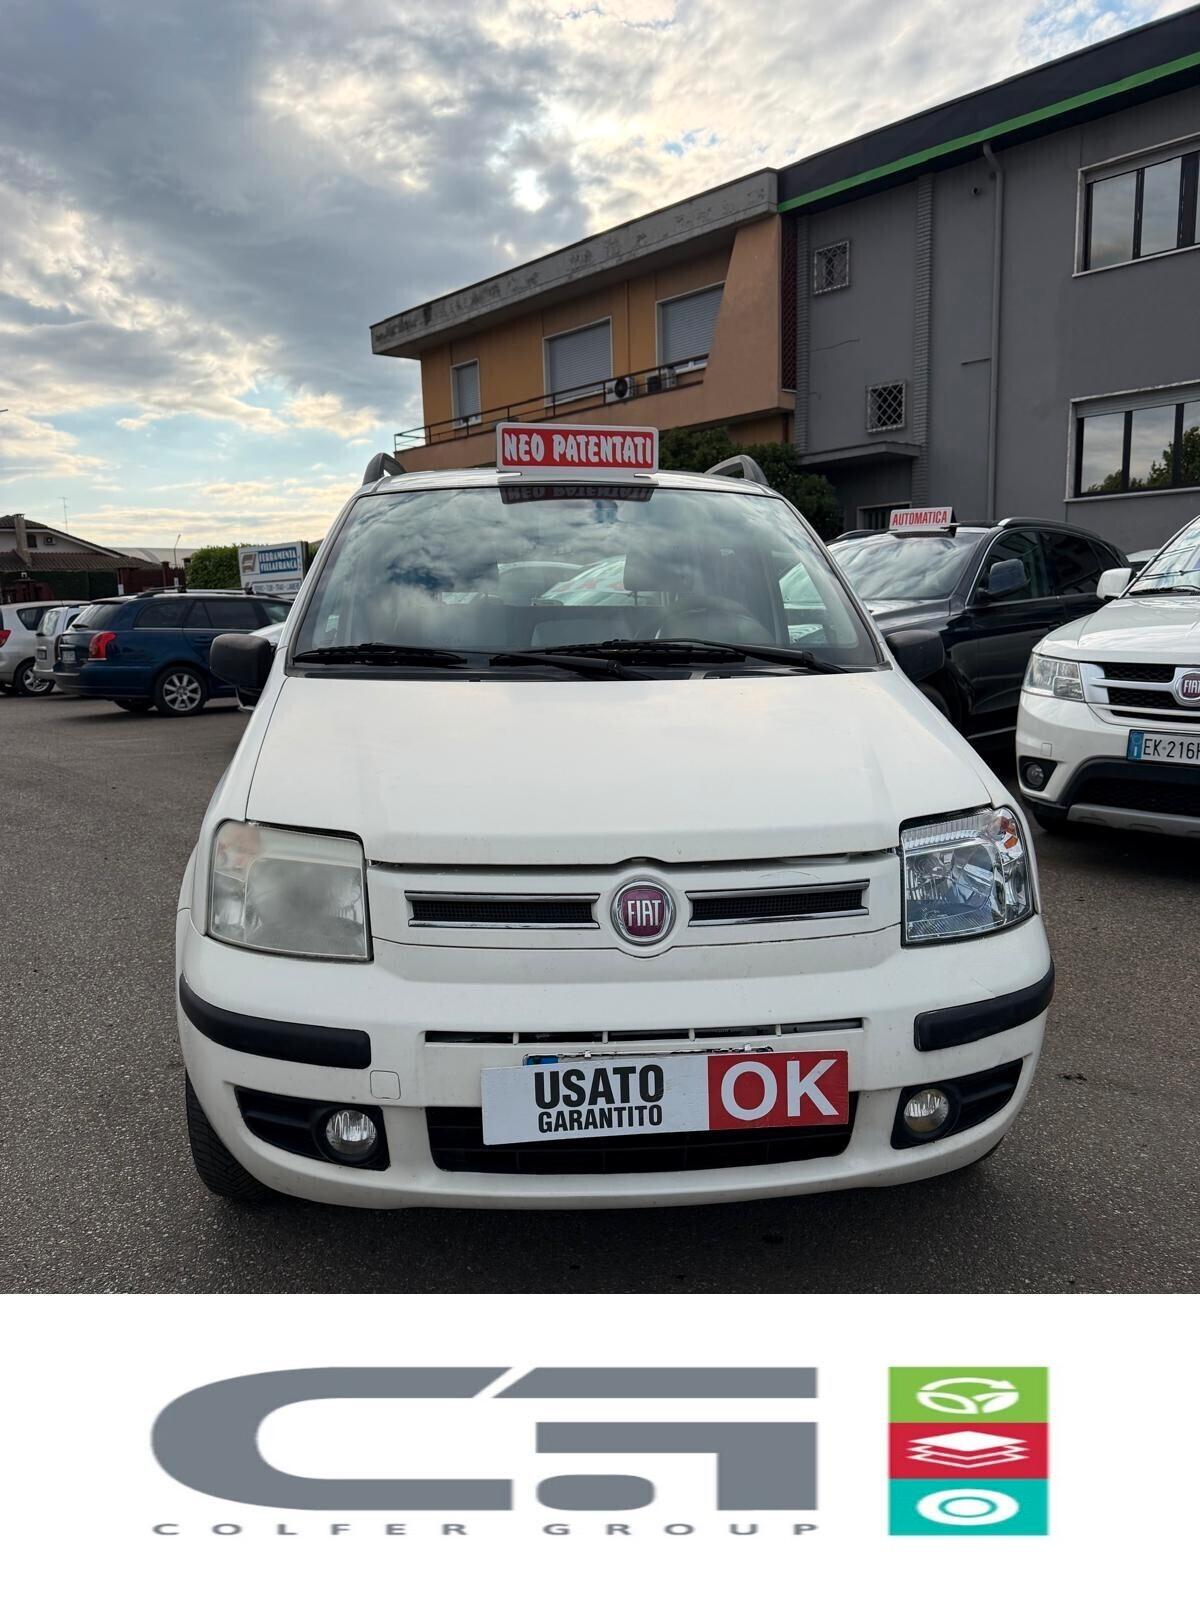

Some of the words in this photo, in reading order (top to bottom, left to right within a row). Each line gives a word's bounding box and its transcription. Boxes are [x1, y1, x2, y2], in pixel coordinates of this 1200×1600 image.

[504, 433, 545, 462] NEO
[552, 434, 652, 464] PATENTATI
[892, 511, 947, 526] AUTOMATICA
[627, 900, 661, 927] FIAT
[534, 1064, 665, 1109] USATO
[721, 1059, 840, 1121] OK
[538, 1104, 662, 1133] GARANTITO
